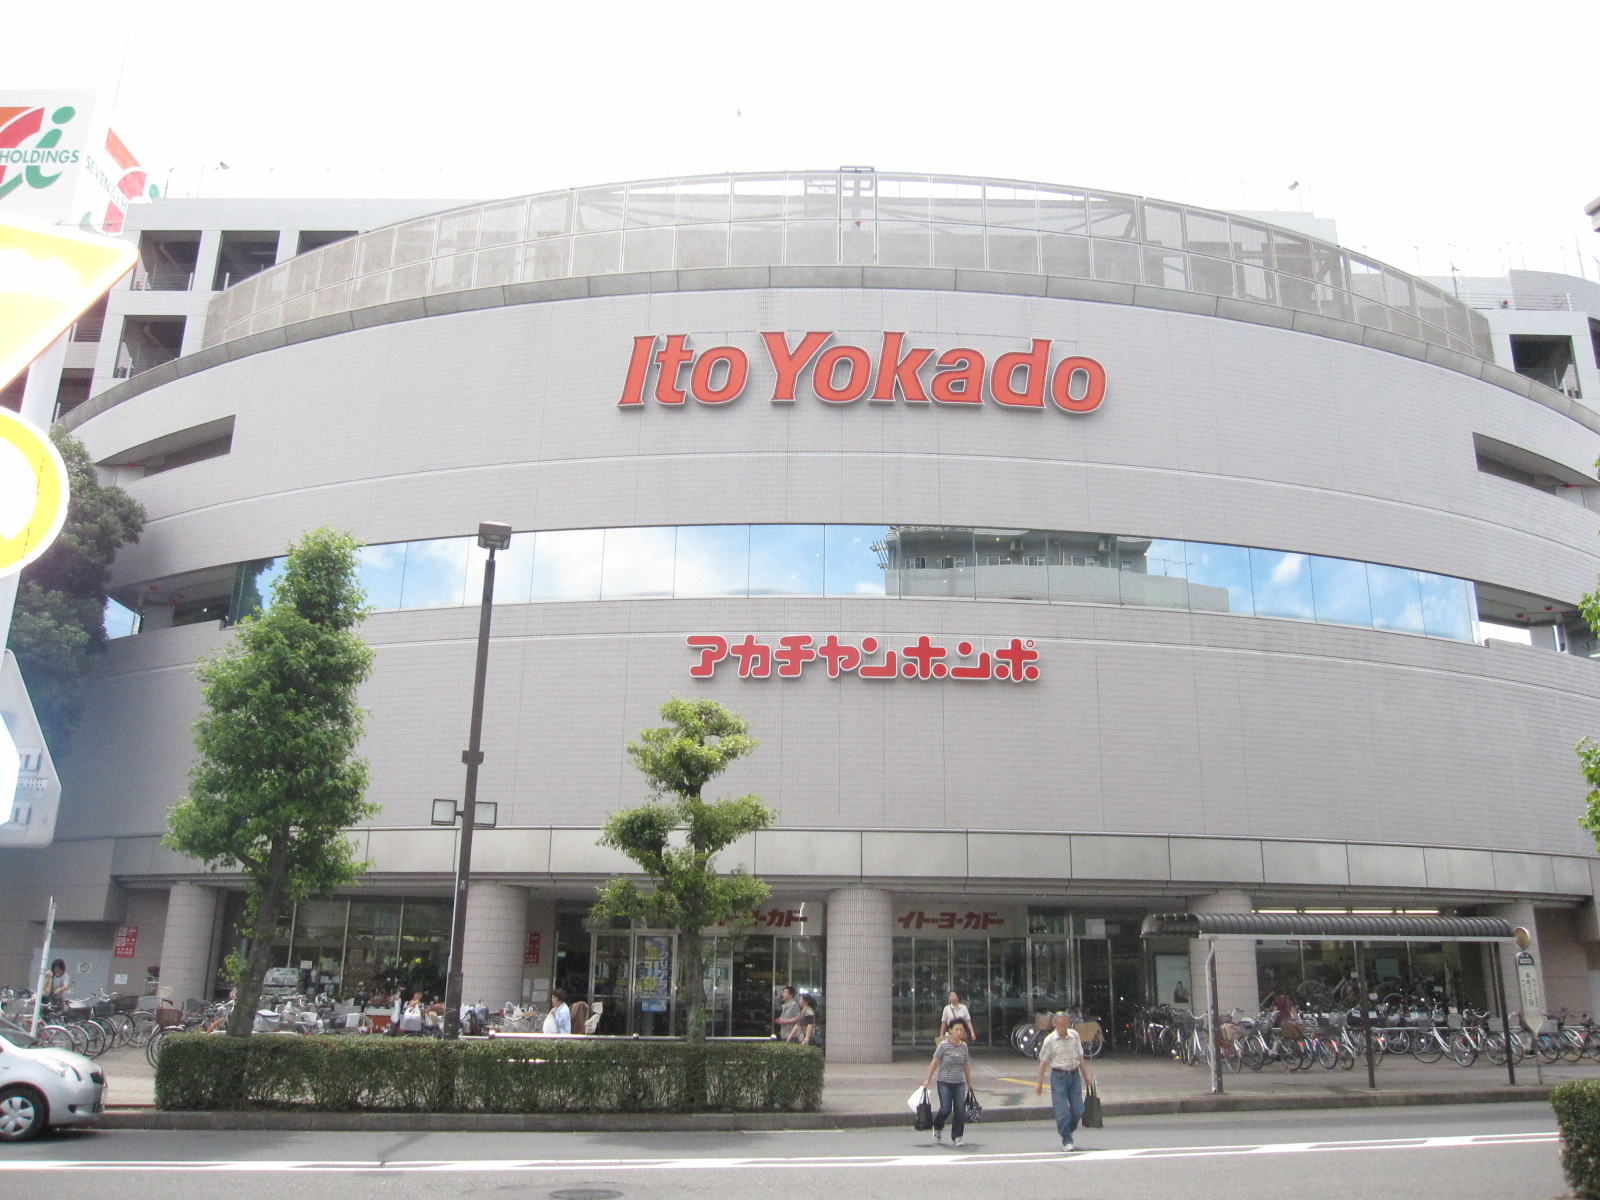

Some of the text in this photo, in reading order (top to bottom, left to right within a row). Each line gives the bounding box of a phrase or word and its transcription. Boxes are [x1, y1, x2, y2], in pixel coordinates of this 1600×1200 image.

[0, 149, 80, 164] HOLDINGS
[616, 329, 1107, 414] Ito Yokado
[897, 910, 1004, 929] イトーヨーカドー
